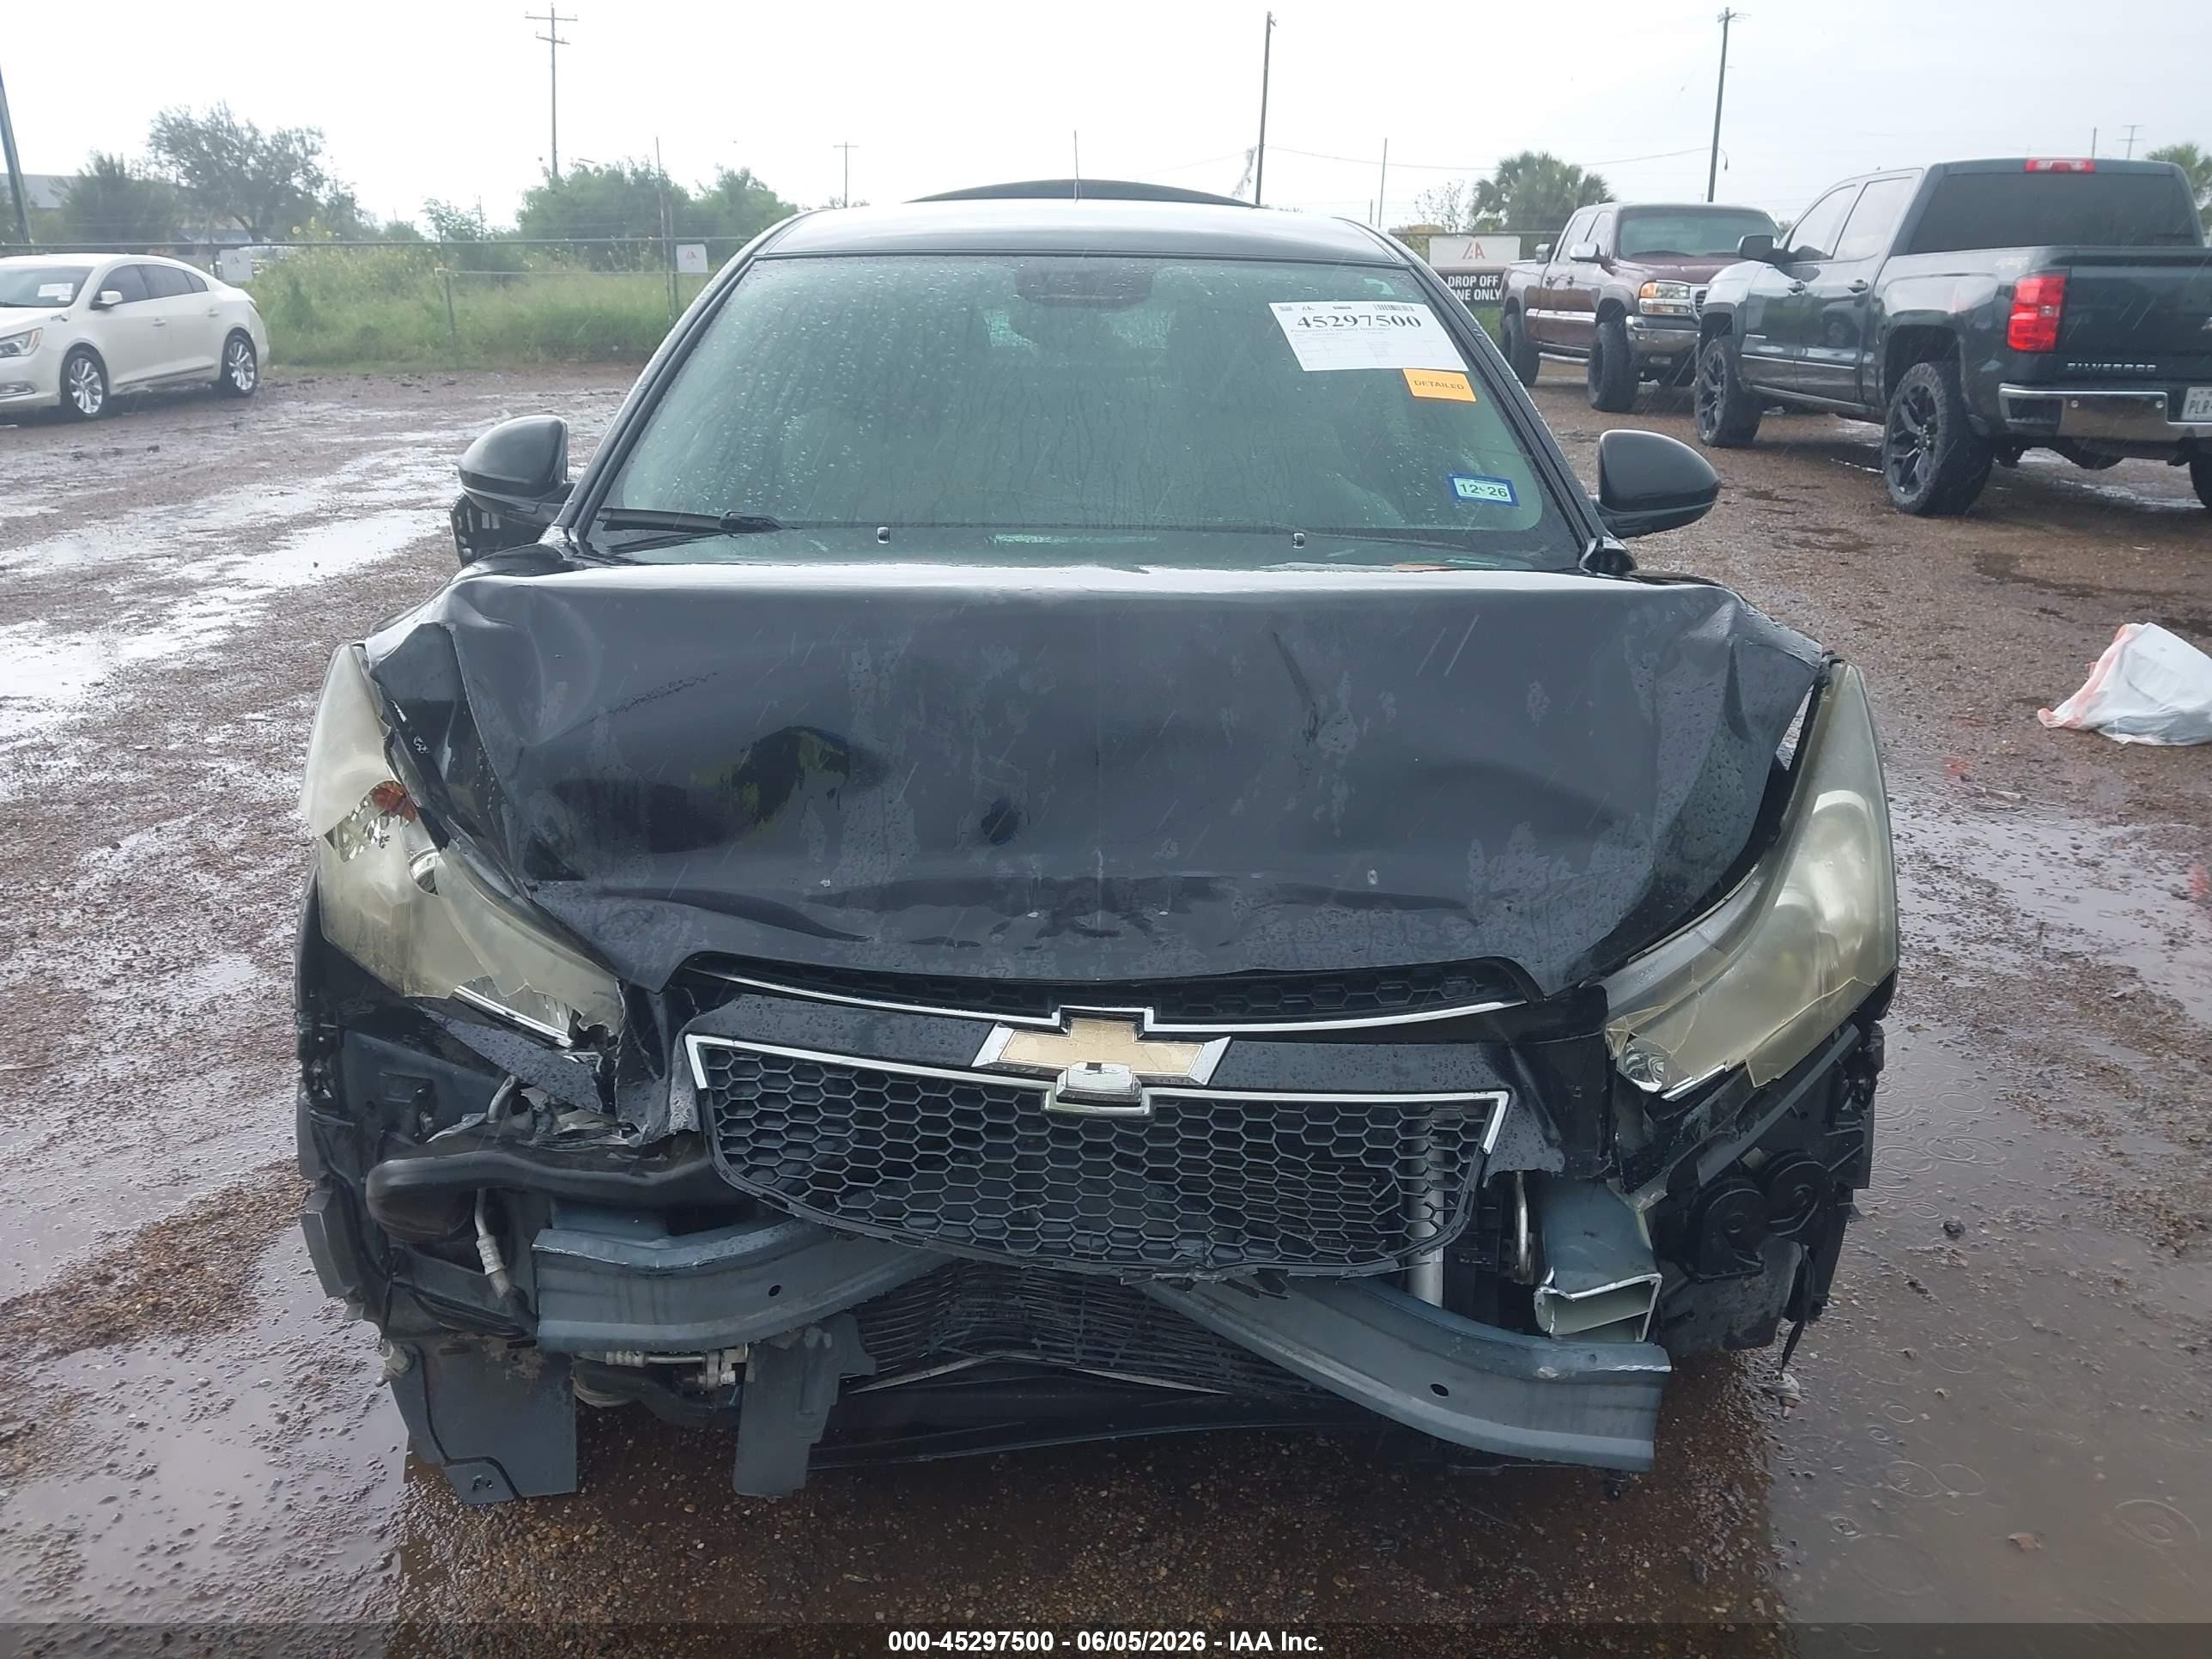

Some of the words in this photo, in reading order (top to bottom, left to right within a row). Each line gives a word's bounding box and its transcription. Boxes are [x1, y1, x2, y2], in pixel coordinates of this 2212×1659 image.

[1448, 275, 1477, 288] DROP
[1479, 275, 1498, 288] OFF
[1474, 289, 1500, 301] ONLY
[1297, 314, 1422, 328] 45297500
[1413, 380, 1465, 390] DETAILED
[1459, 483, 1480, 495] 12
[1487, 486, 1508, 497] 26
